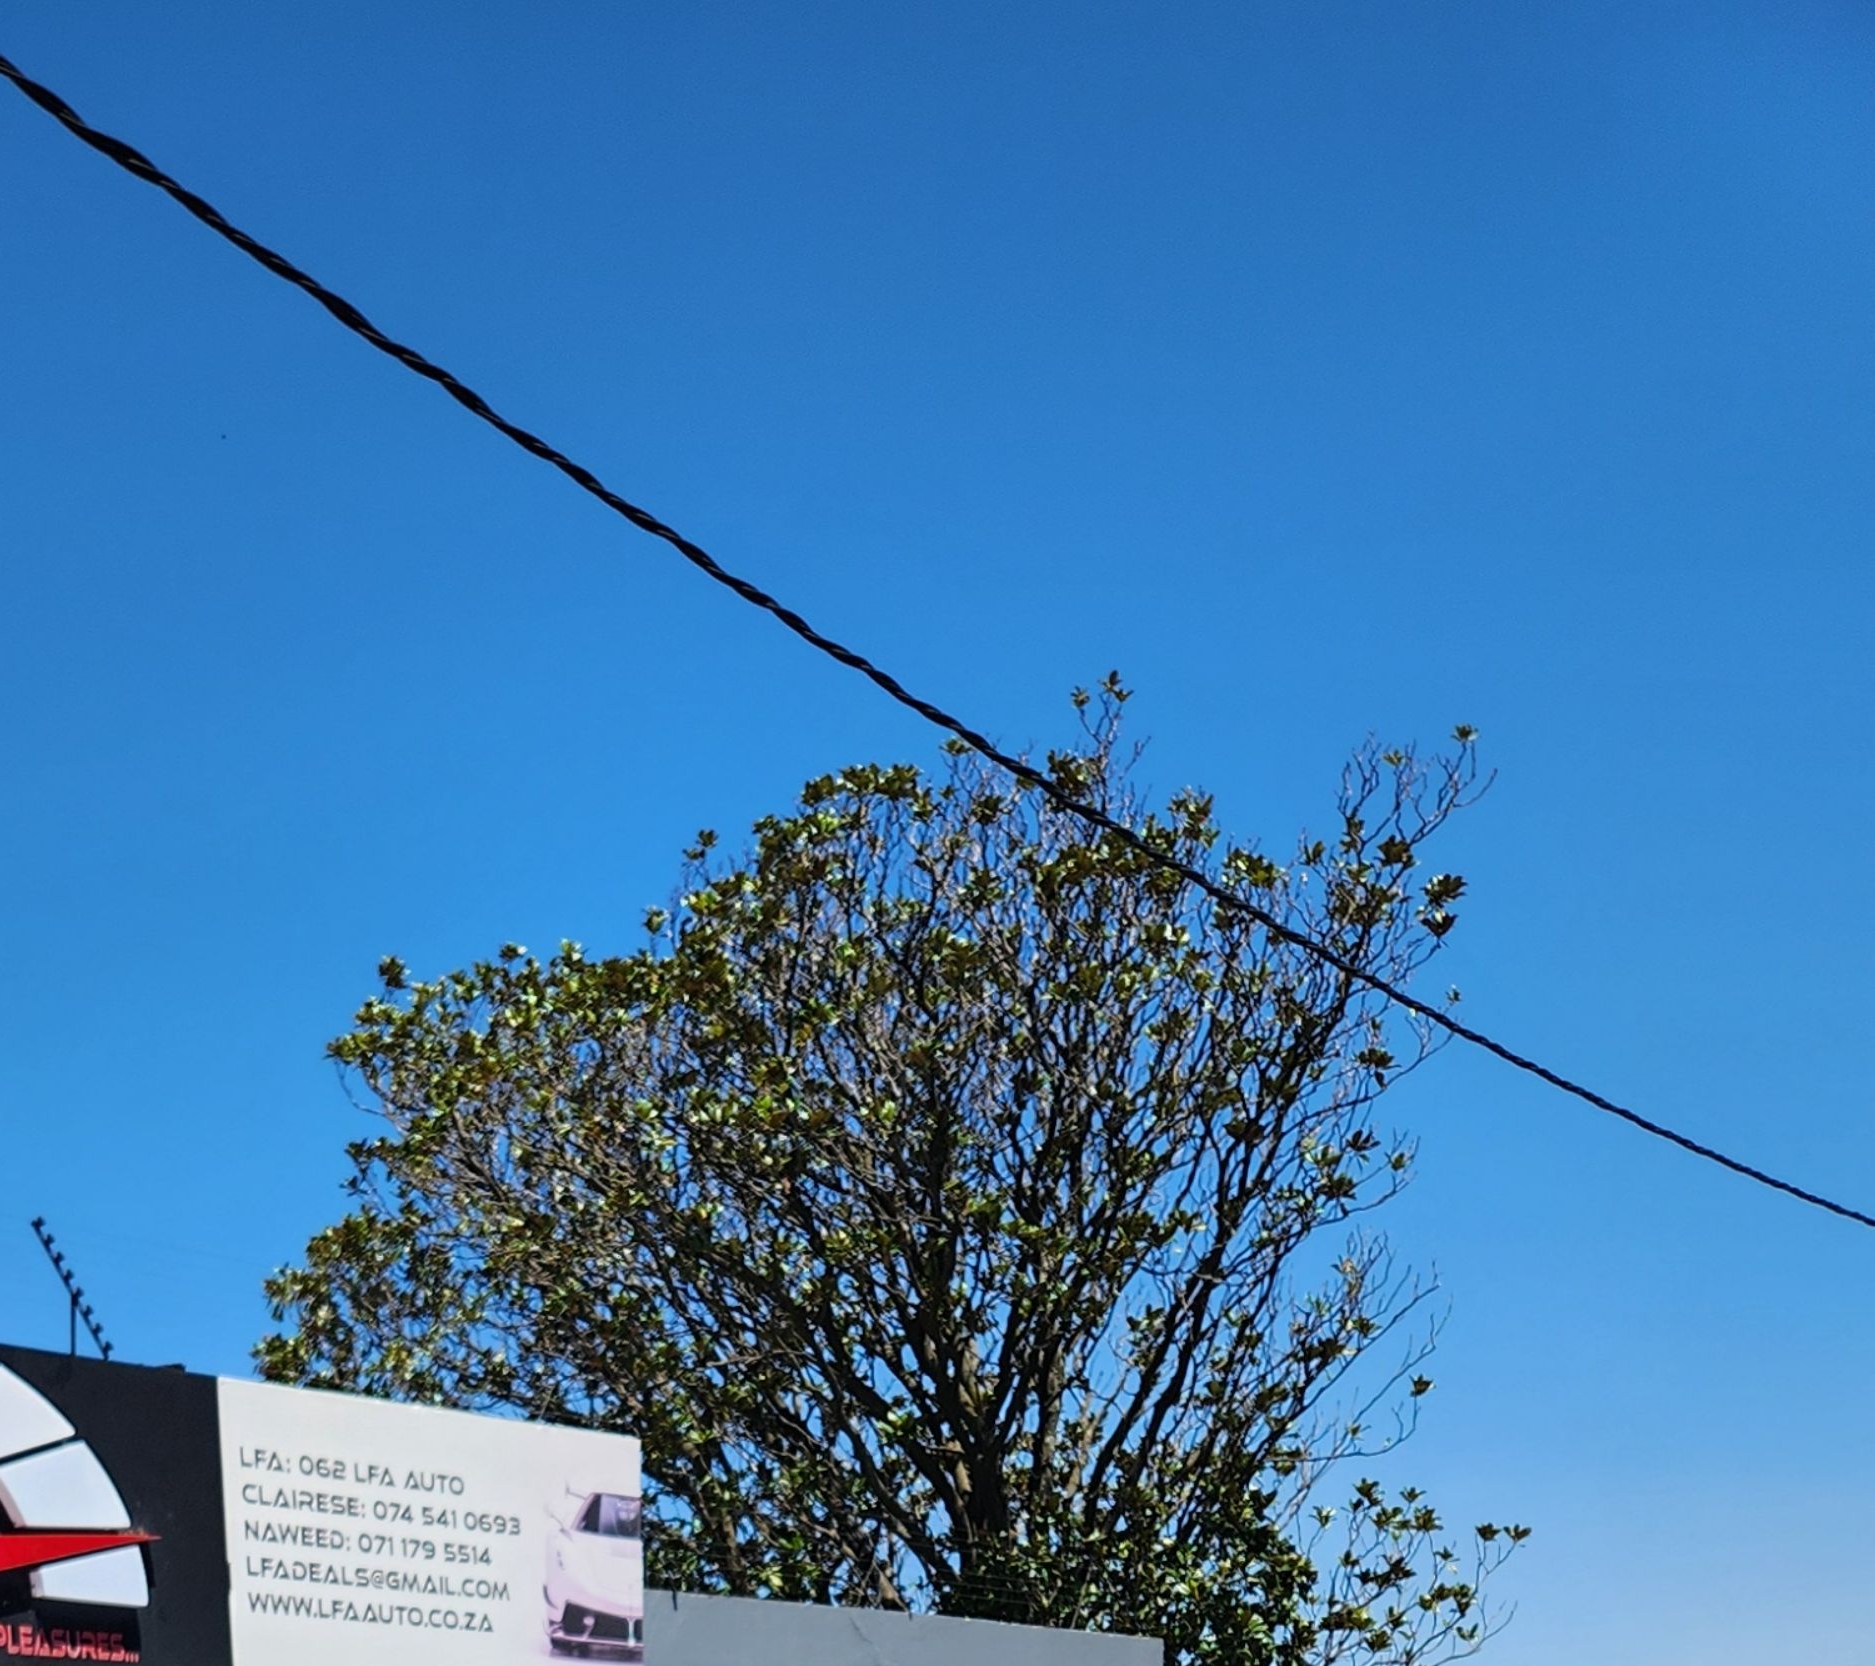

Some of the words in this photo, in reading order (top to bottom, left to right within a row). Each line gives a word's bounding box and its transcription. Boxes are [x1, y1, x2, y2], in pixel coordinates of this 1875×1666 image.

[239, 1446, 291, 1473] LFA:
[298, 1455, 347, 1480] 062
[354, 1464, 394, 1488] LFA
[404, 1471, 465, 1497] AUTO
[242, 1483, 366, 1519] CLAIRESE:
[373, 1500, 414, 1524] 074
[421, 1505, 457, 1529] 541
[463, 1511, 521, 1536] 0693
[244, 1520, 351, 1552] NAWEED:
[357, 1533, 395, 1556] 071
[401, 1537, 436, 1560] 179
[443, 1542, 492, 1566] 5514
[245, 1556, 510, 1601] LFADEALS@GMAIL.COM
[247, 1593, 494, 1633] WWW.LFAAUTO.CO.ZA
